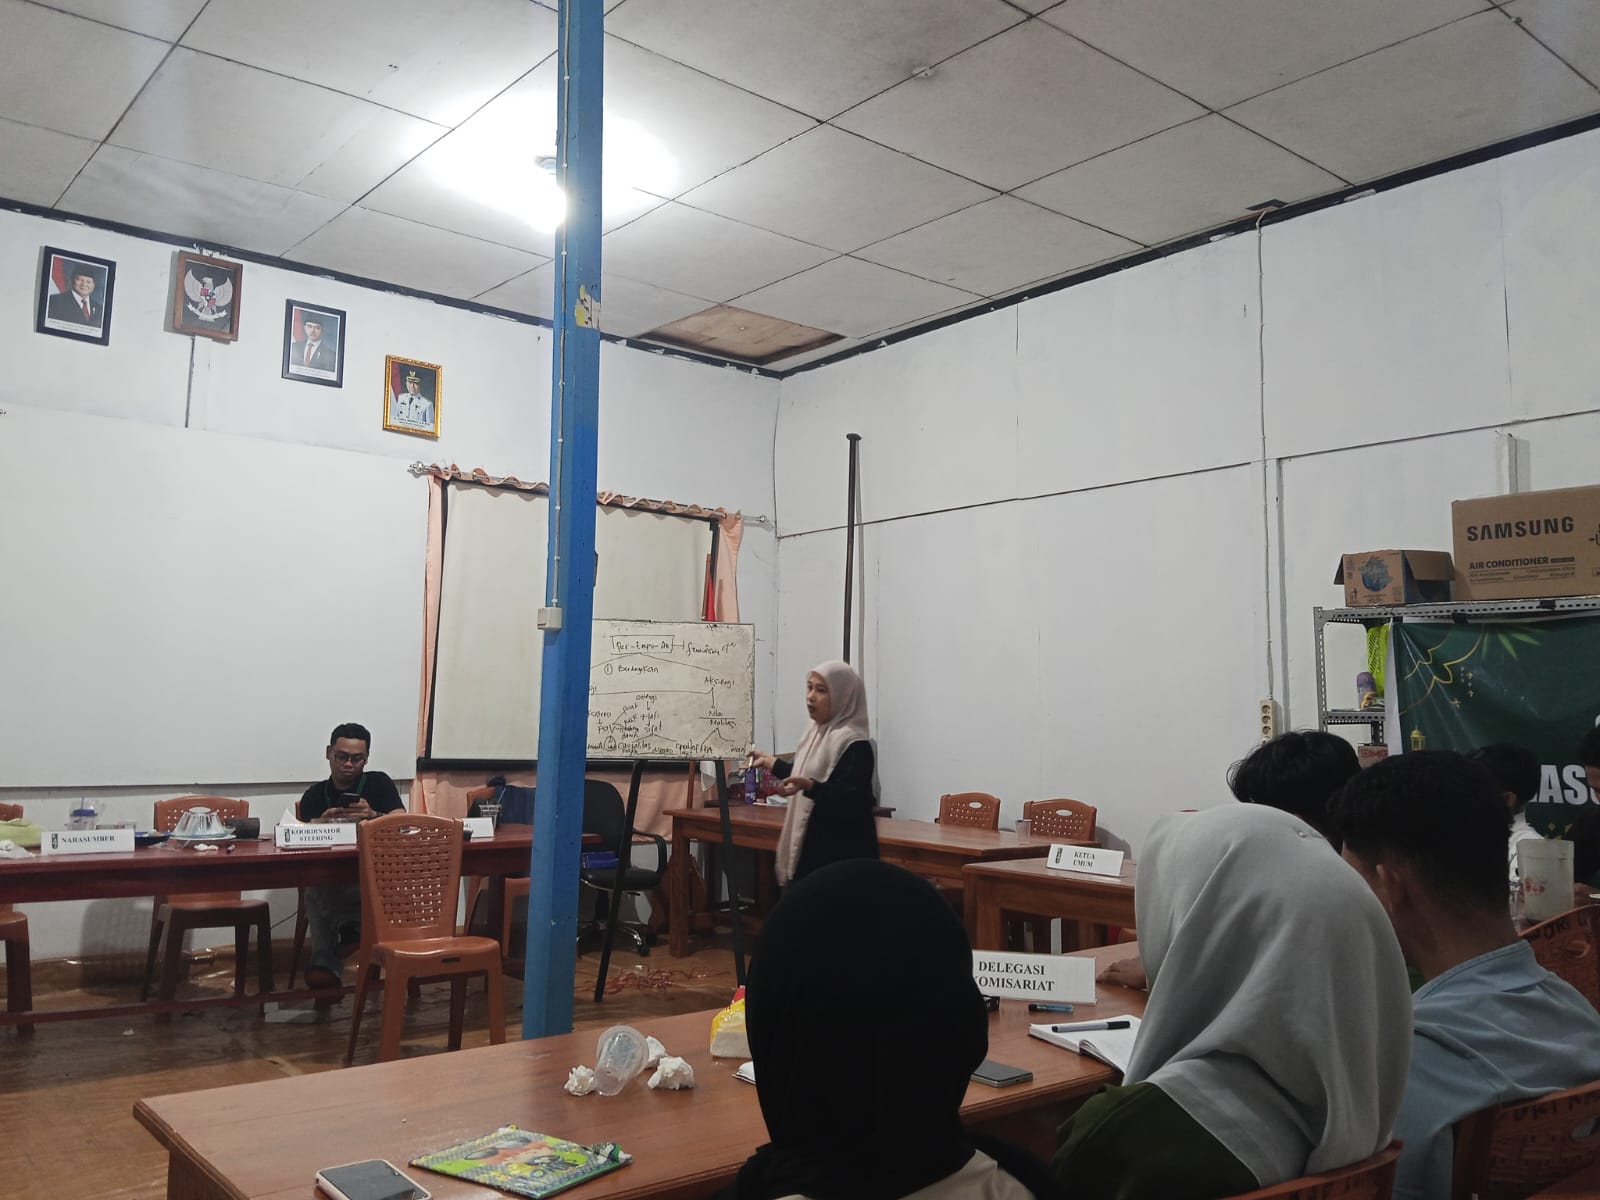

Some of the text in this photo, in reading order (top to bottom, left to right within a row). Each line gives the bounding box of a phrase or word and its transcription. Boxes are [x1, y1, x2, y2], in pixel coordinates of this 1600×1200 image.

[1466, 515, 1574, 542] SAMSUNG
[1469, 561, 1486, 570] AIR
[1487, 556, 1549, 568] CONDITIONER
[1528, 764, 1600, 805] AS
[61, 835, 115, 844] NARASUMBER
[1074, 851, 1095, 860] KETUA
[1073, 859, 1093, 867] UMUM
[978, 961, 1045, 975] DELEGASI
[974, 976, 1055, 991] OMISARIAT
